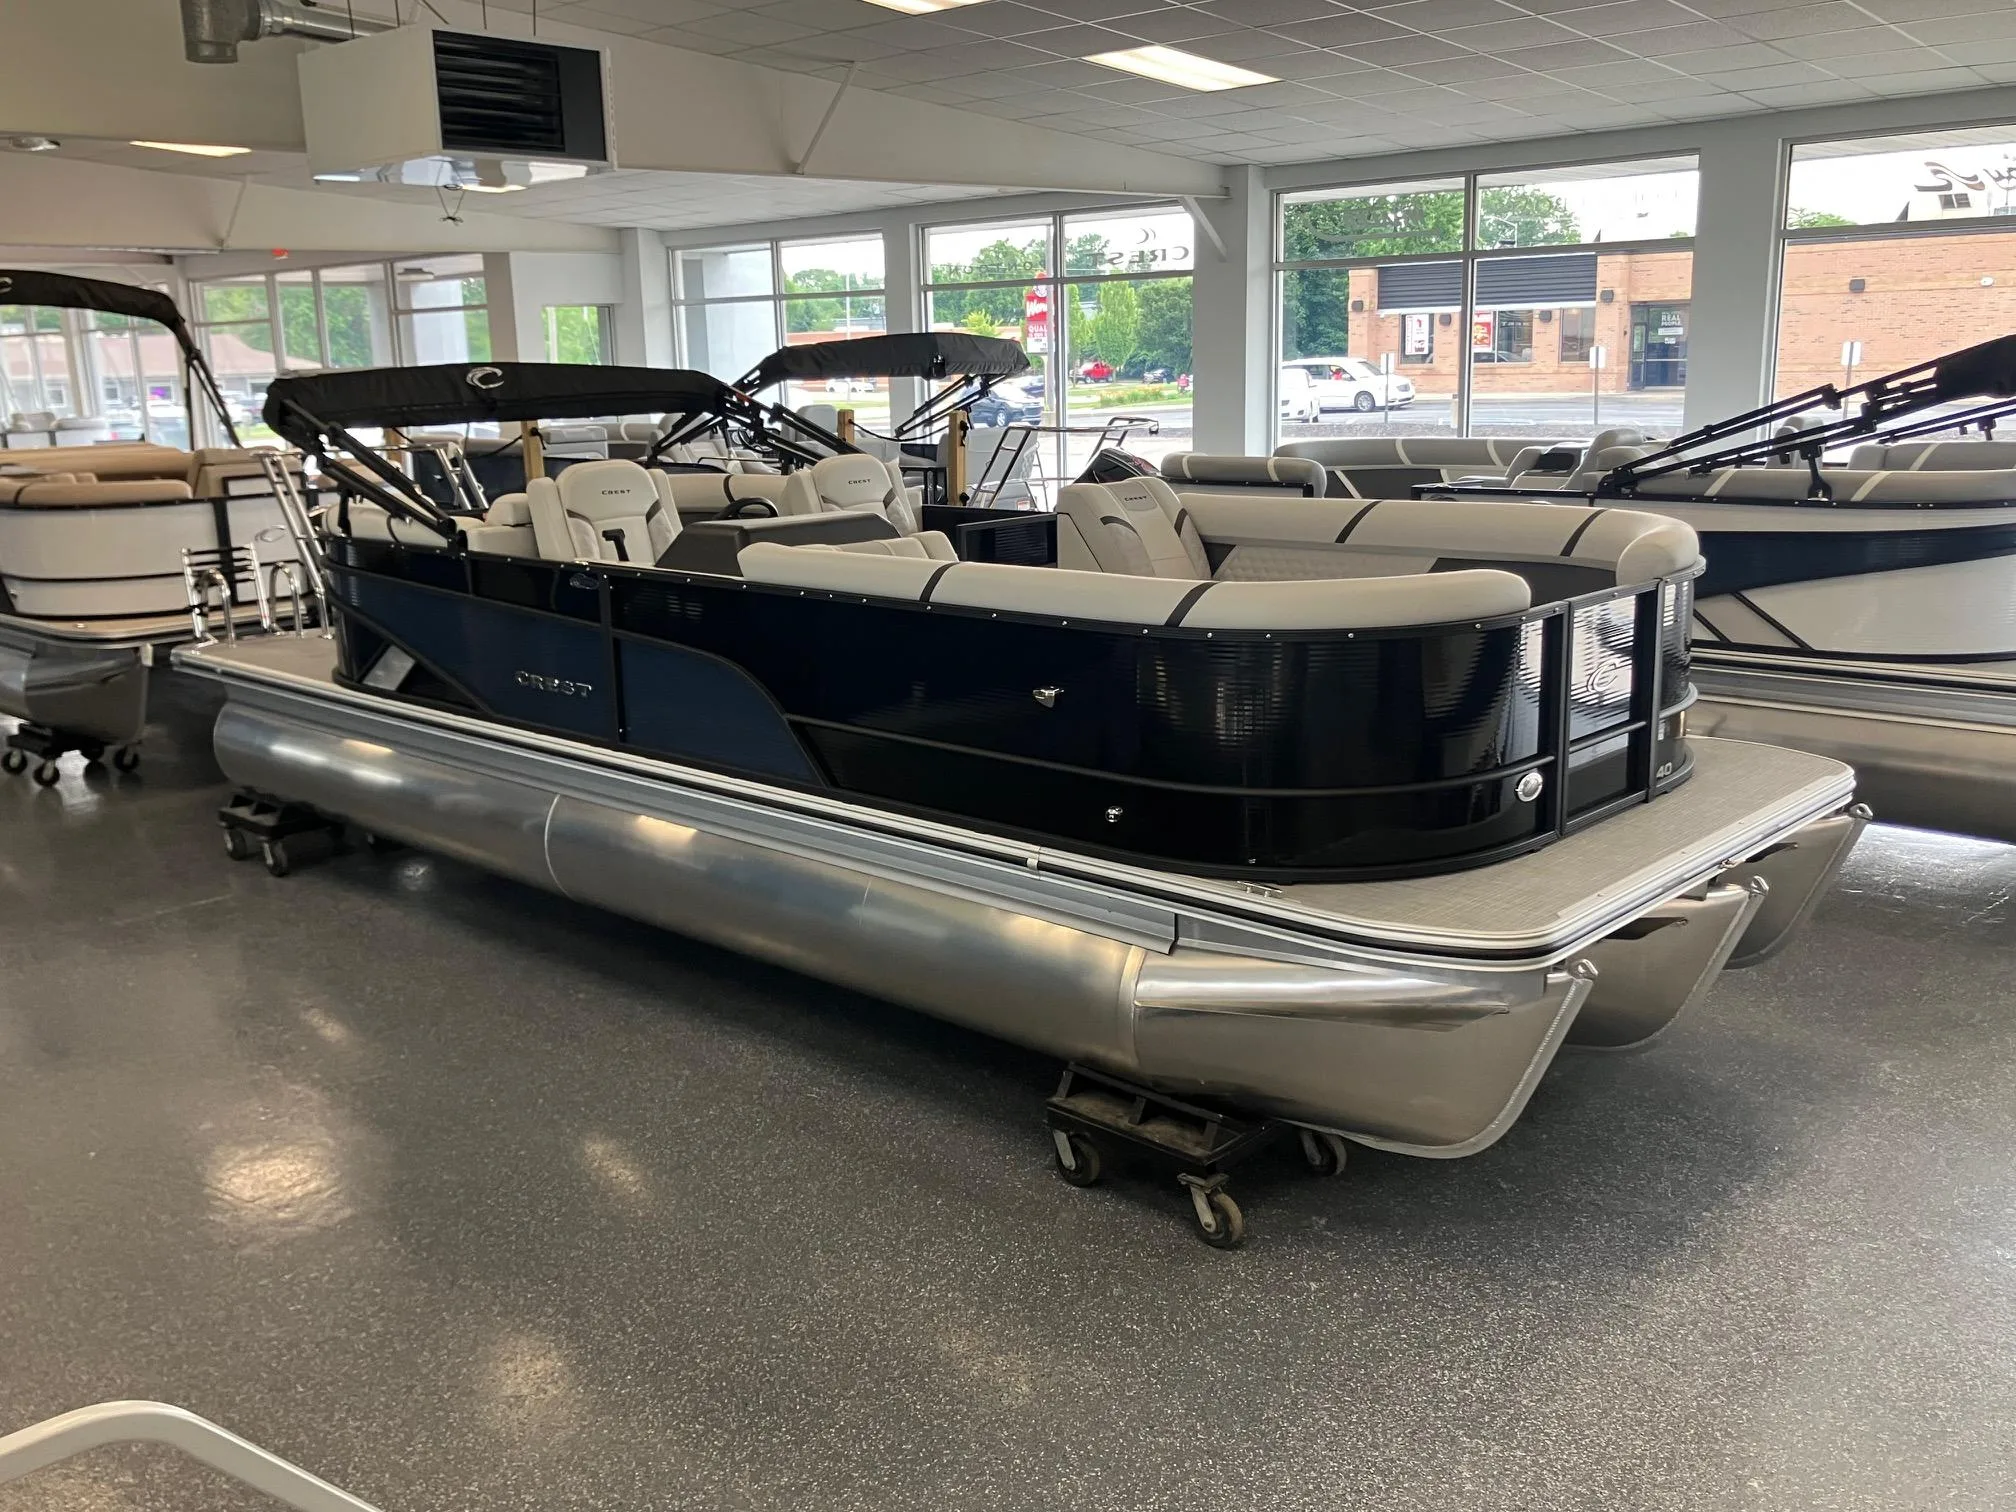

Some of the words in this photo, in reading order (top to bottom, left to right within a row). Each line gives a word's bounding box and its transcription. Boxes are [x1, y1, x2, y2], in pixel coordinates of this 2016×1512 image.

[1026, 299, 1048, 318] Wen
[1028, 323, 1048, 333] QUAL
[515, 670, 592, 698] CREST
[1656, 761, 1673, 778] 40
